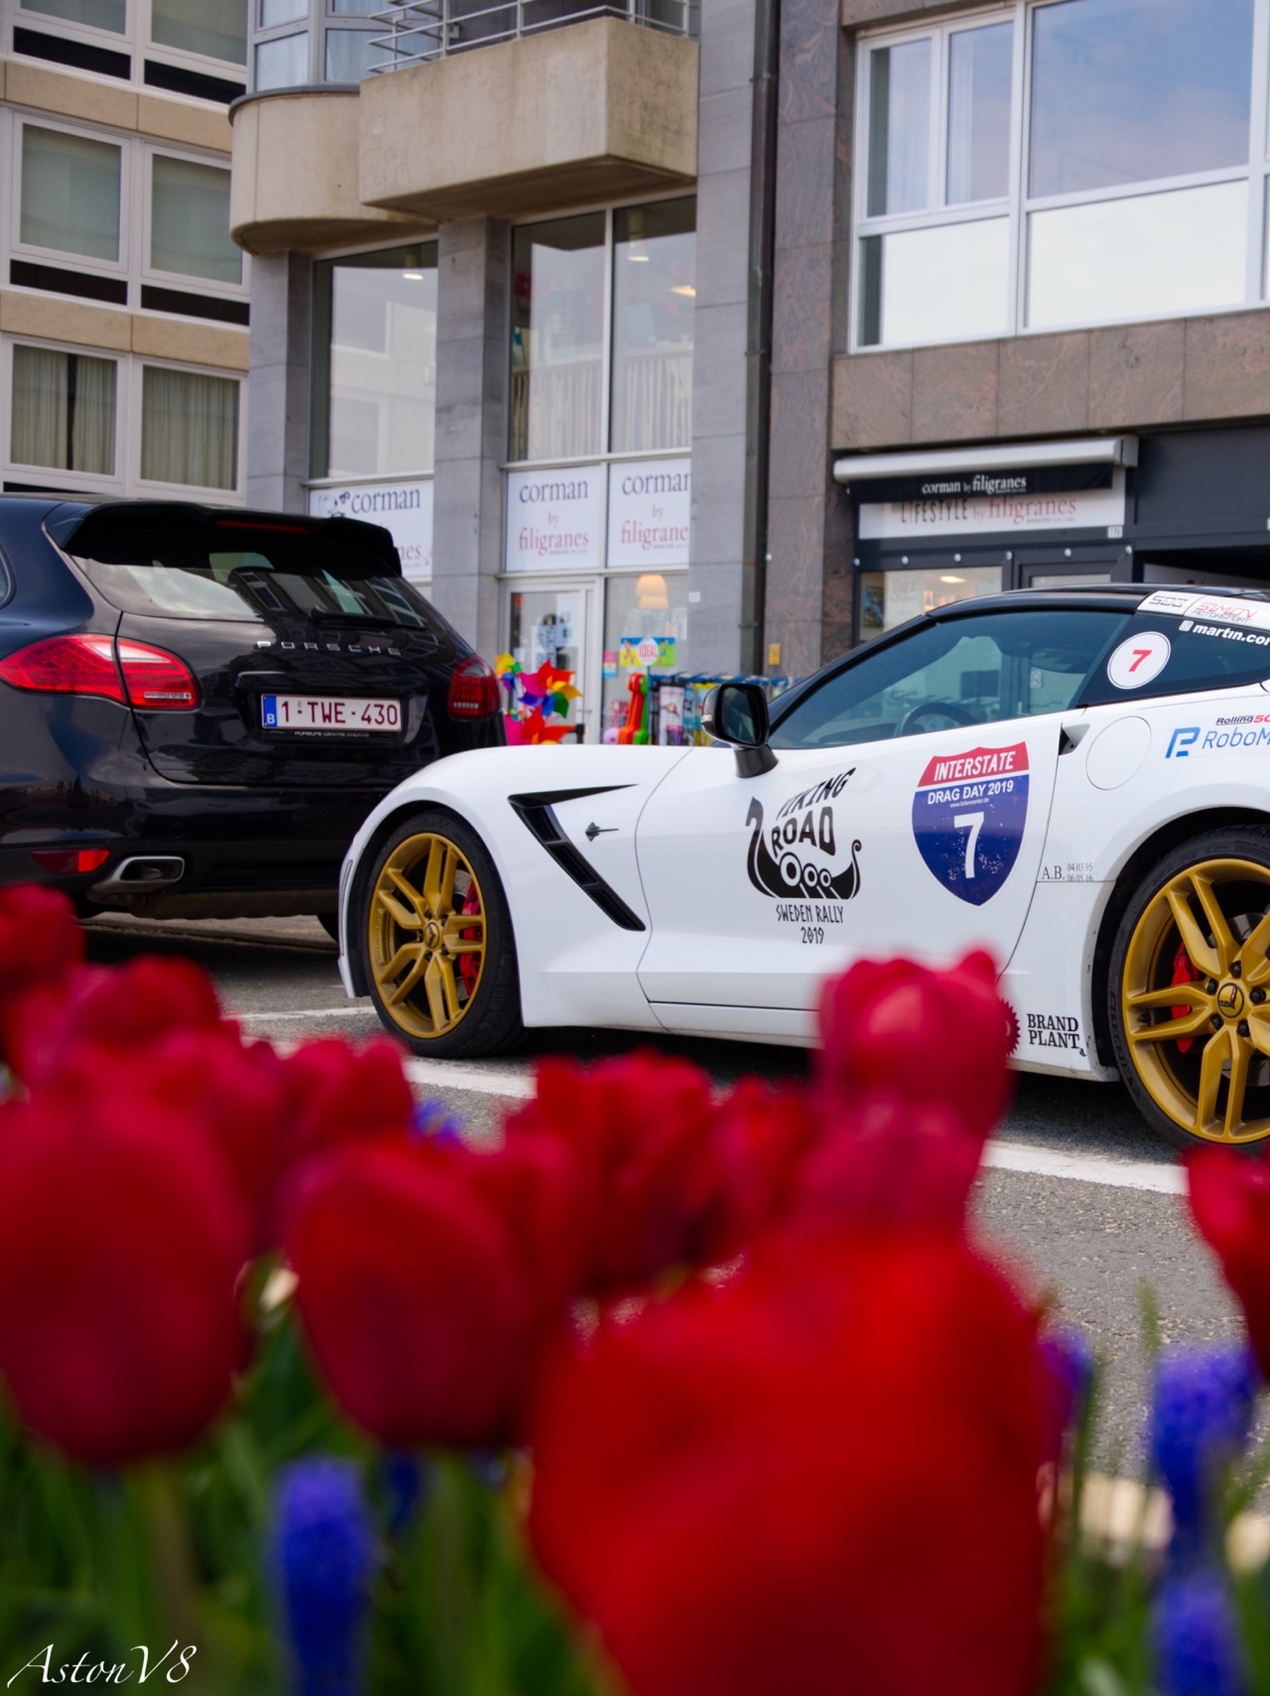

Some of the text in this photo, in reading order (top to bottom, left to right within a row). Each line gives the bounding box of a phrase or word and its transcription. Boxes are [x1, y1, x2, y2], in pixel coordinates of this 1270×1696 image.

[520, 480, 589, 503] corman
[921, 474, 1027, 495] corman by filigranes
[351, 488, 421, 514] corman
[652, 503, 664, 521] by
[972, 505, 985, 523] by
[988, 497, 1077, 525] filigranes
[548, 511, 560, 528] by
[518, 527, 590, 556] filigranes
[620, 520, 690, 550] filigrane
[256, 640, 401, 656] PORSCHE
[1128, 649, 1153, 673] 7
[266, 713, 276, 725] B
[933, 750, 1017, 782] INTERSTATE
[775, 767, 857, 822] VIKING
[927, 779, 1014, 805] DRAG DAY 2019
[771, 806, 837, 860] ROAD
[953, 811, 985, 879] 7
[1041, 865, 1065, 880] A.B.
[775, 904, 844, 923] SWEDEN RALLY
[800, 927, 825, 945] 2019
[1026, 1013, 1079, 1032] BRAND
